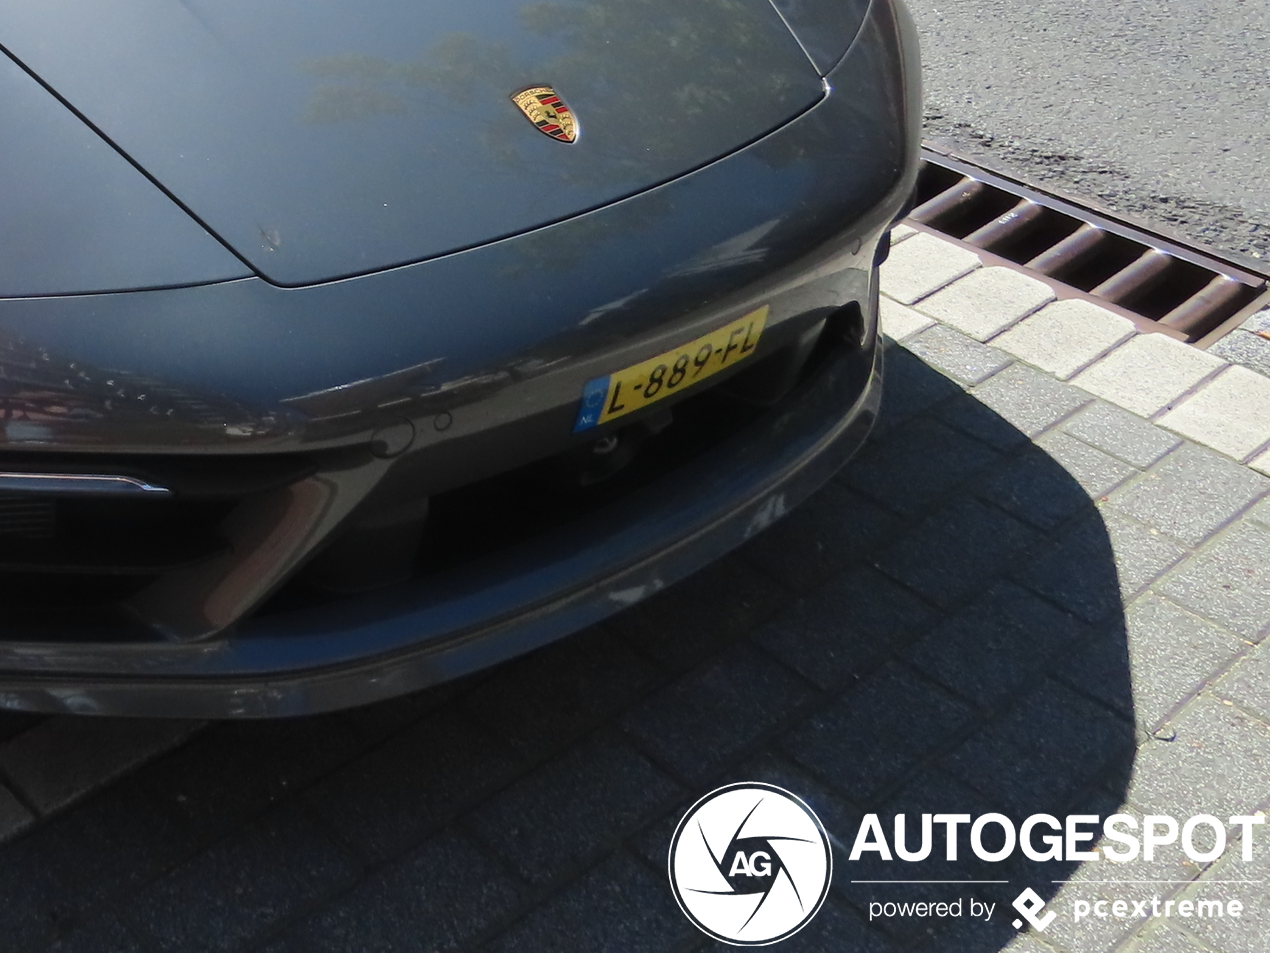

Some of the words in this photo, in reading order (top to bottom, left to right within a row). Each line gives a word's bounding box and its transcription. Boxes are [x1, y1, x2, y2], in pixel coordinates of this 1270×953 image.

[514, 88, 554, 104] PORSCHE
[606, 321, 755, 415] L-889-FL
[580, 415, 594, 425] NL
